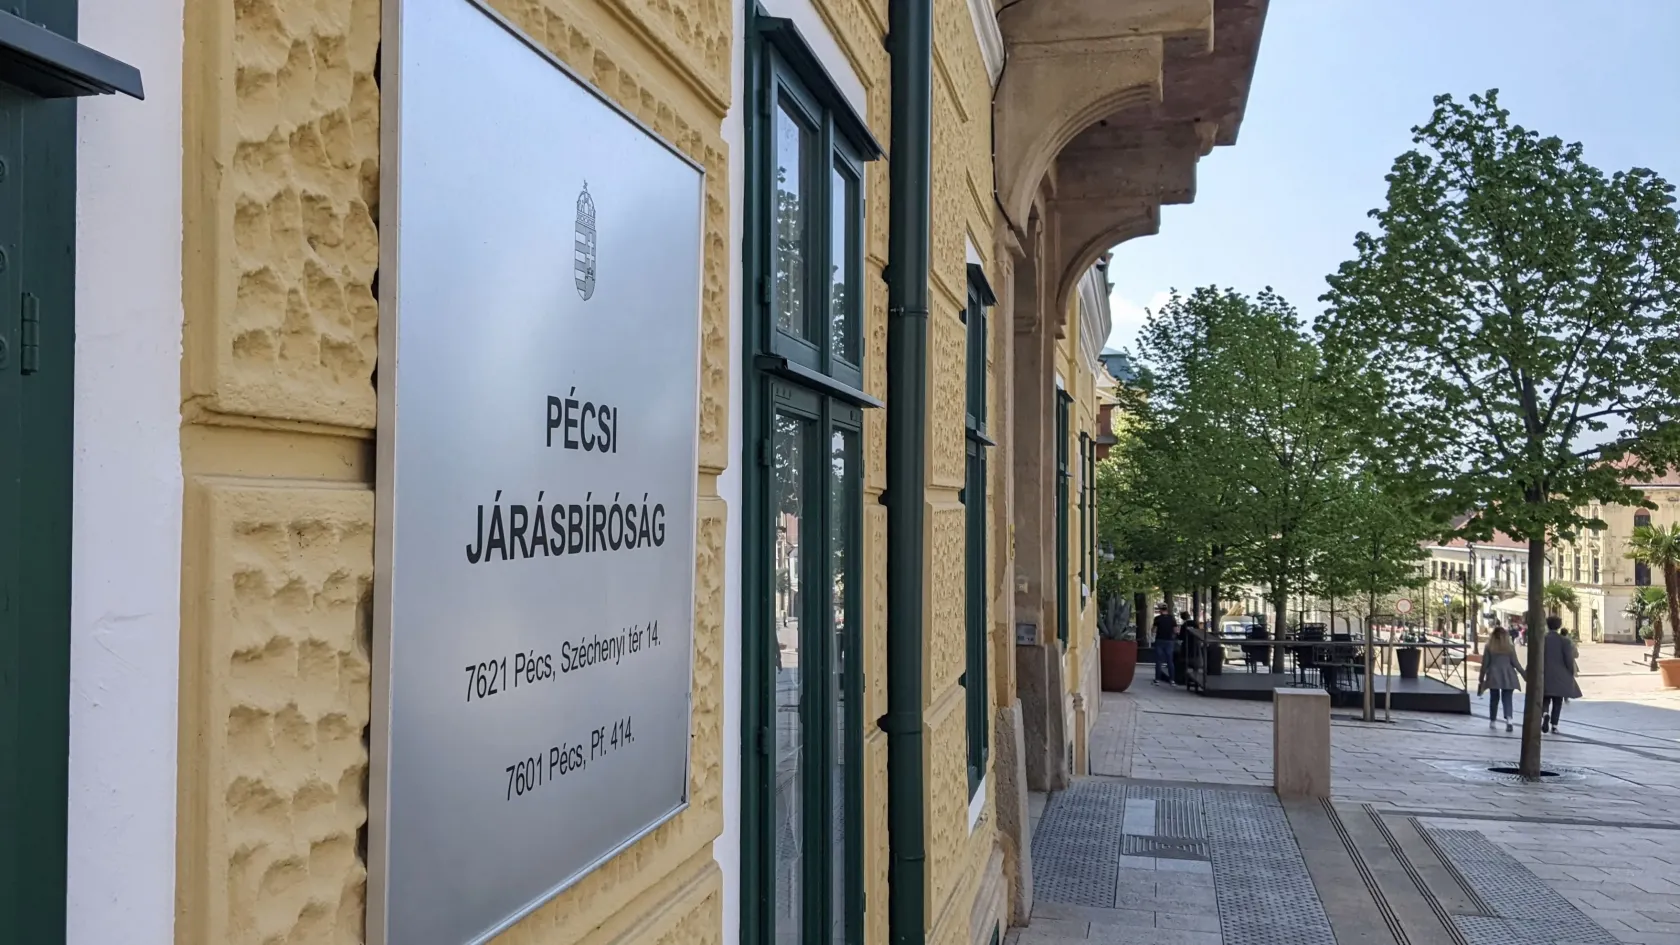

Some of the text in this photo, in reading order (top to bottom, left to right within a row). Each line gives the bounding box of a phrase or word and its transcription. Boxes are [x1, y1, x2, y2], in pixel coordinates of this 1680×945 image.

[546, 386, 618, 454] PÉCSI
[465, 489, 666, 565] JÁRÁSBÍRÓSÁG
[465, 619, 662, 702] 7621 Pécs, Széchenyi tér 14.
[505, 715, 635, 802] 7601 Pécs, Pf. 414.
